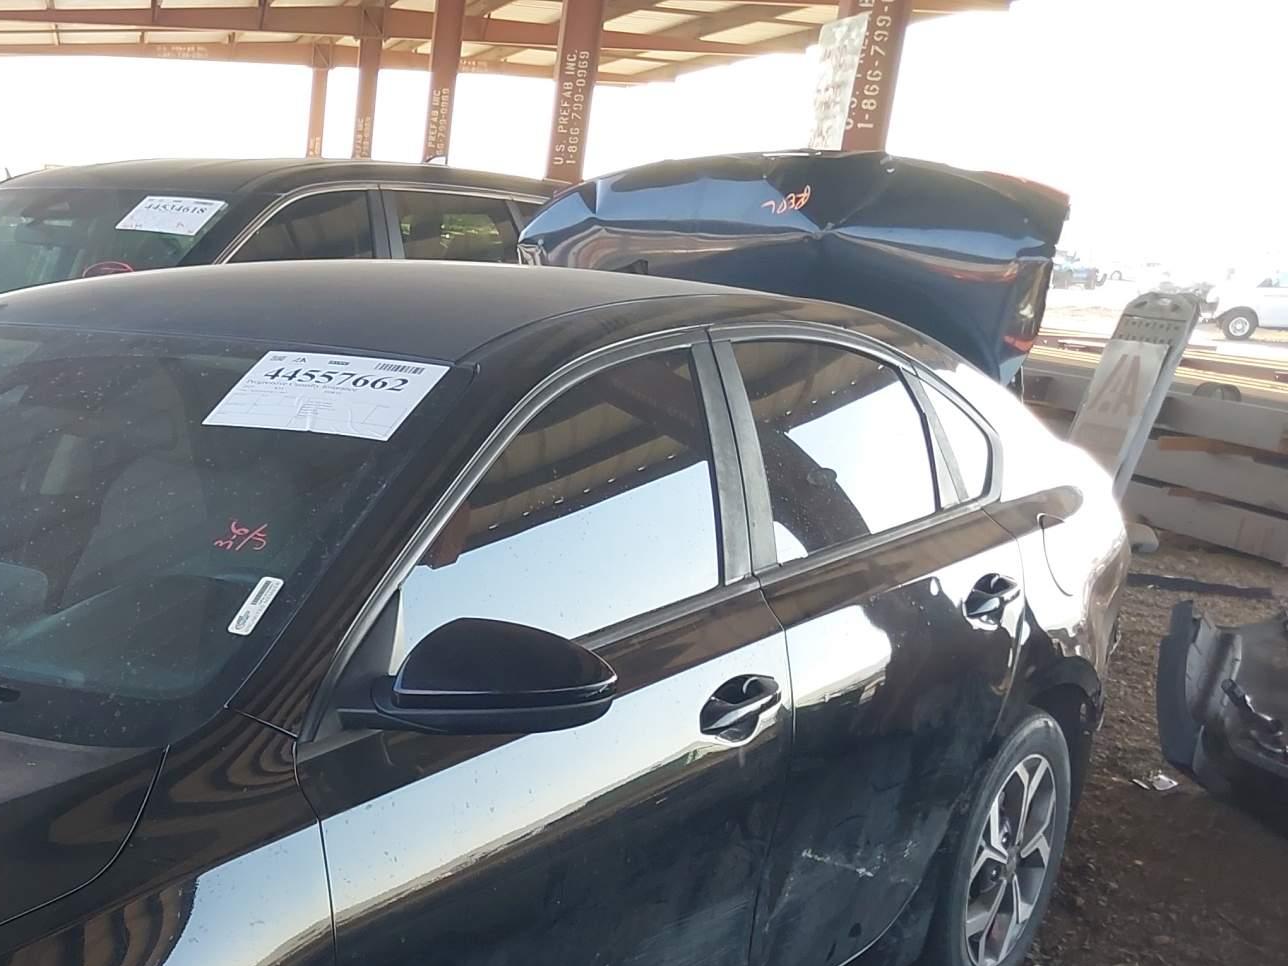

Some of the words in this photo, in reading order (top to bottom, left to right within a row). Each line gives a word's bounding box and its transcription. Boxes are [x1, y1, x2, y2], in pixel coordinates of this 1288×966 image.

[557, 81, 573, 133] PREFAB
[565, 50, 578, 75] INC.
[566, 51, 590, 164] 1-866-799-0969
[857, 0, 892, 129] 1-866-799-
[264, 366, 409, 392] 44557662
